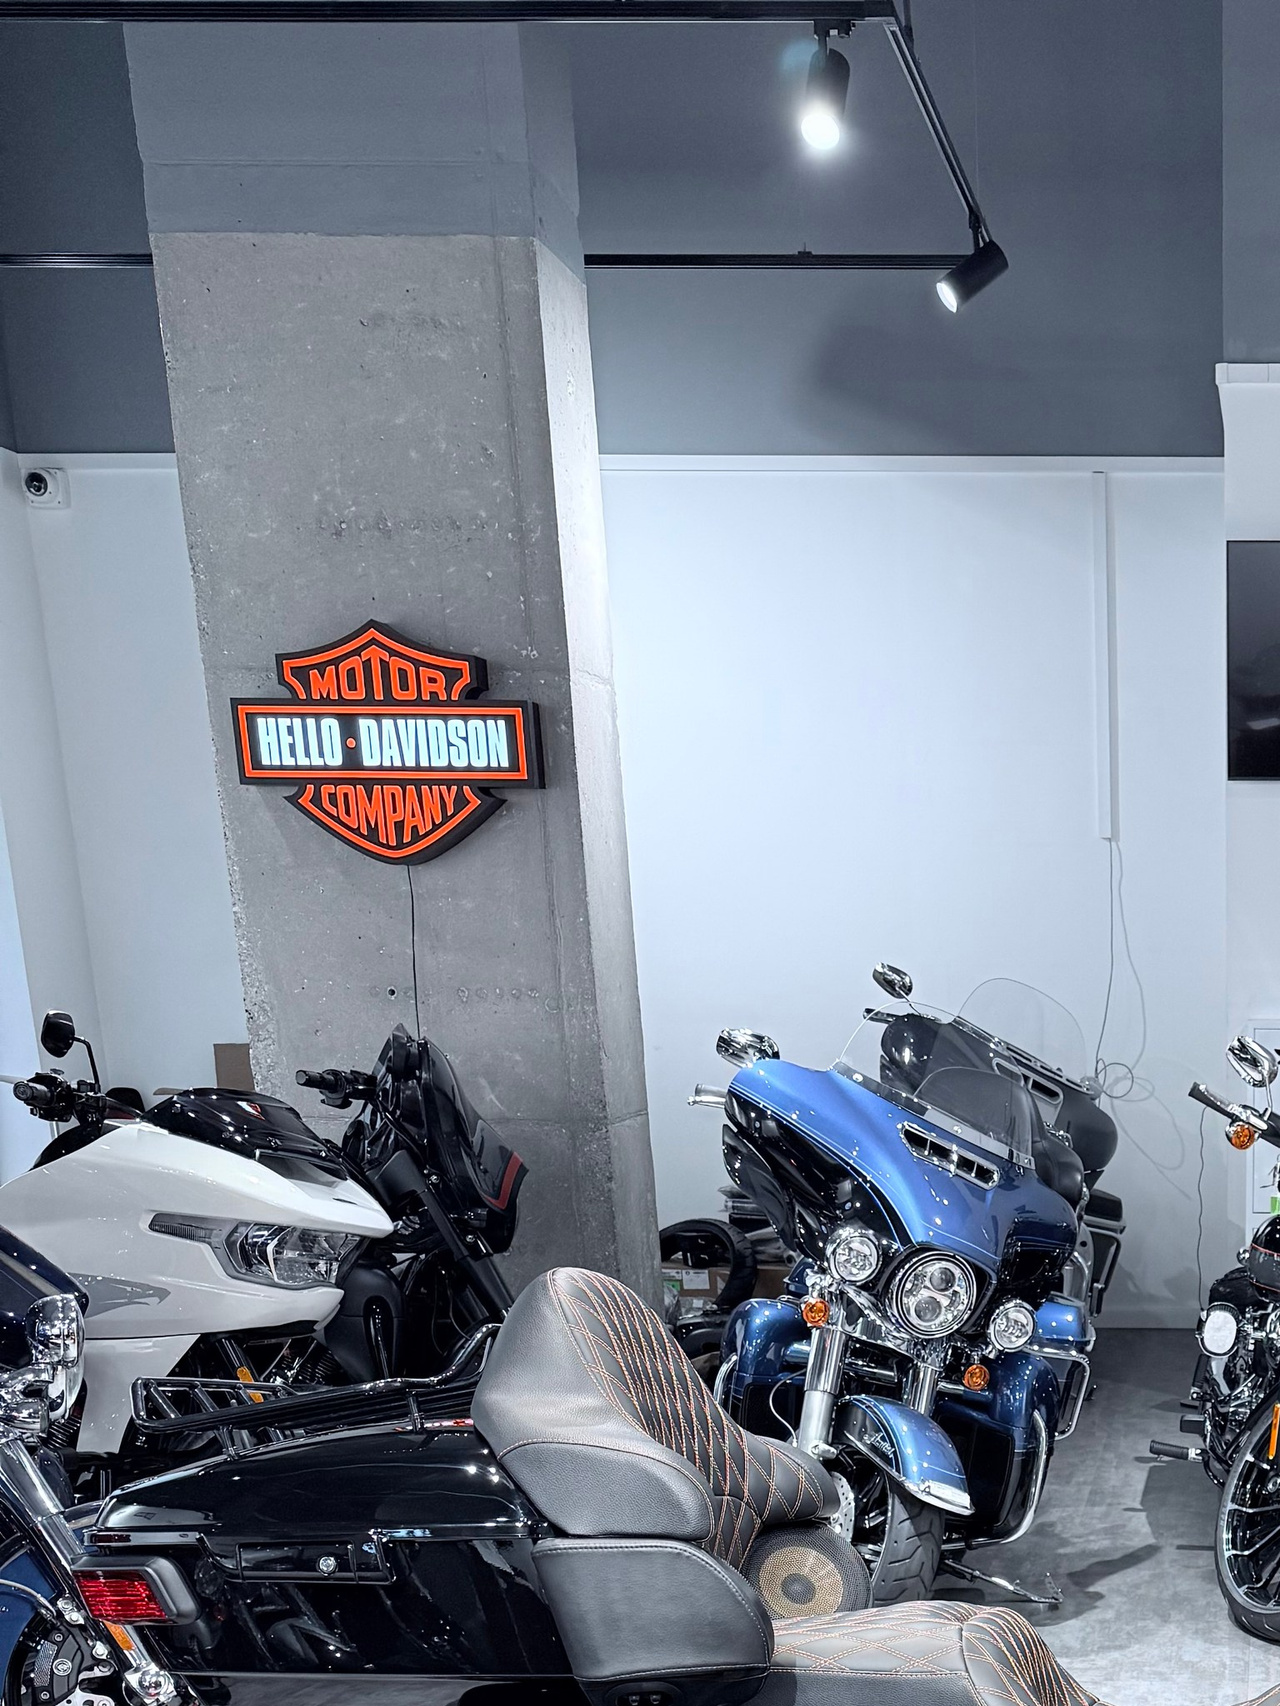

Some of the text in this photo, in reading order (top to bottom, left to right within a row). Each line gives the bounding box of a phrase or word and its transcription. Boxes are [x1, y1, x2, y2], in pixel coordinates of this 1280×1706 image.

[309, 645, 447, 700] MOTOR
[256, 717, 510, 768] HELLO DAVIDSON
[321, 785, 459, 847] COMPANY
